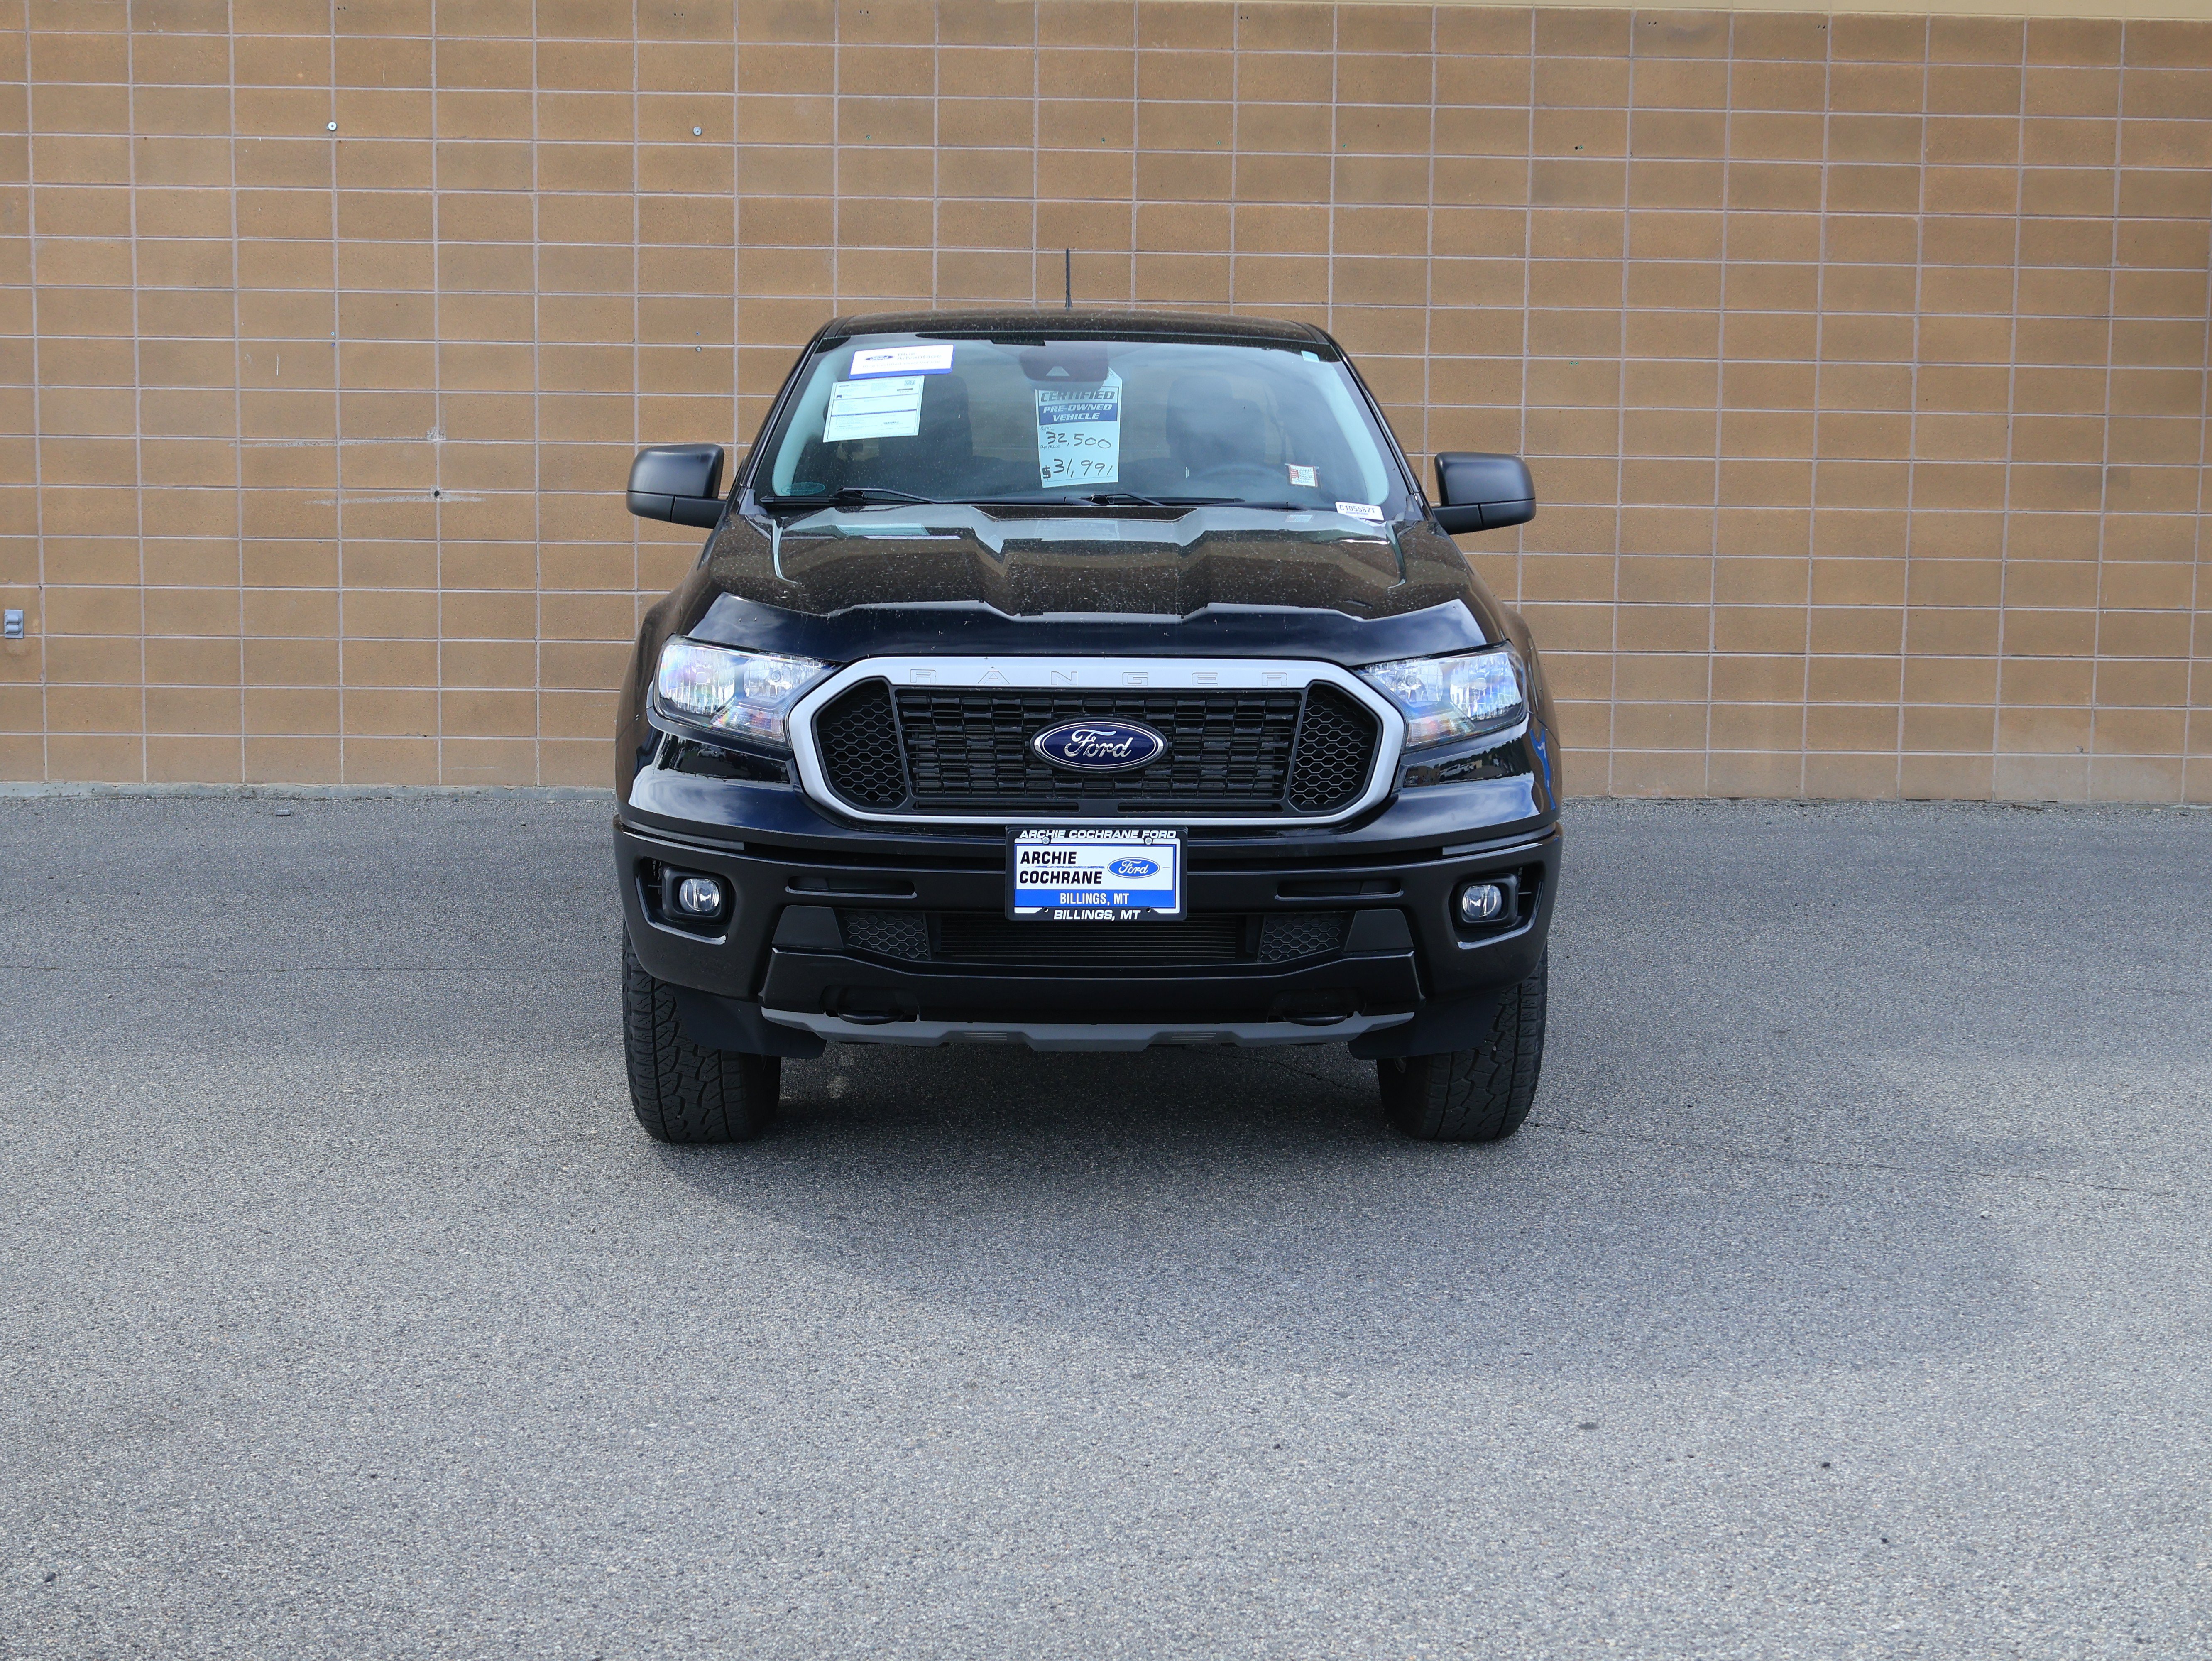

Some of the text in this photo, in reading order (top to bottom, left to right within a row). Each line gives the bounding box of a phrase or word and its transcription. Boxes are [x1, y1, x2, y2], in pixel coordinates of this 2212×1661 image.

[1041, 391, 1115, 402] CERTIFIED
[1043, 404, 1112, 413] PRE-OWNED
[1053, 413, 1100, 421] VEHICLE
[1046, 431, 1111, 449] 32,500
[1042, 458, 1113, 481] $31,991
[910, 669, 1287, 686] RANGER
[1064, 729, 1133, 757] Ford
[1019, 830, 1177, 839] ARCHIE COCHRANE FORD
[1020, 851, 1077, 865] ARCHIE
[1118, 860, 1149, 875] Ford
[1019, 871, 1103, 884] COCHRANE
[1060, 893, 1129, 906] BILLINGS, MT
[1054, 909, 1141, 921] BILLINGS, MT
